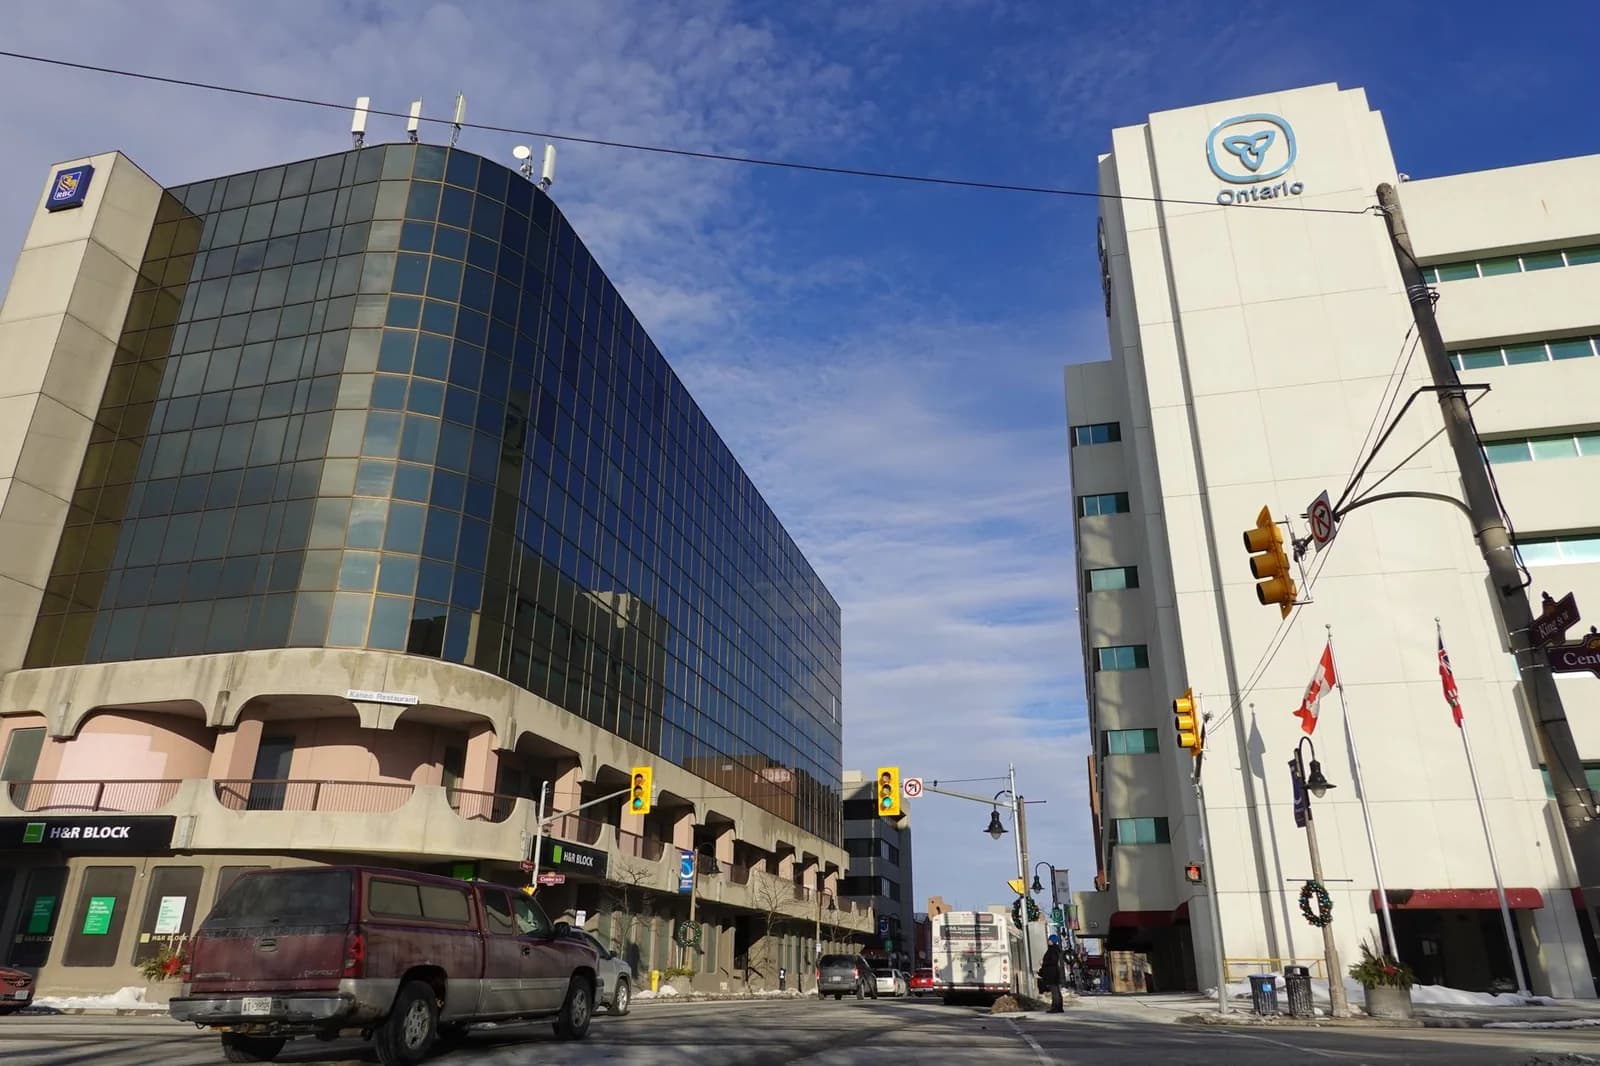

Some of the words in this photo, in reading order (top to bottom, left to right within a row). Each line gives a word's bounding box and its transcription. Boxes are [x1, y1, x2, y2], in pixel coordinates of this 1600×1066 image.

[1216, 181, 1304, 206] Ontario
[1538, 619, 1559, 640] King
[50, 827, 80, 839] H&R
[83, 826, 131, 839] BLOCK
[563, 851, 576, 864] H&R
[575, 853, 594, 867] BLOCK
